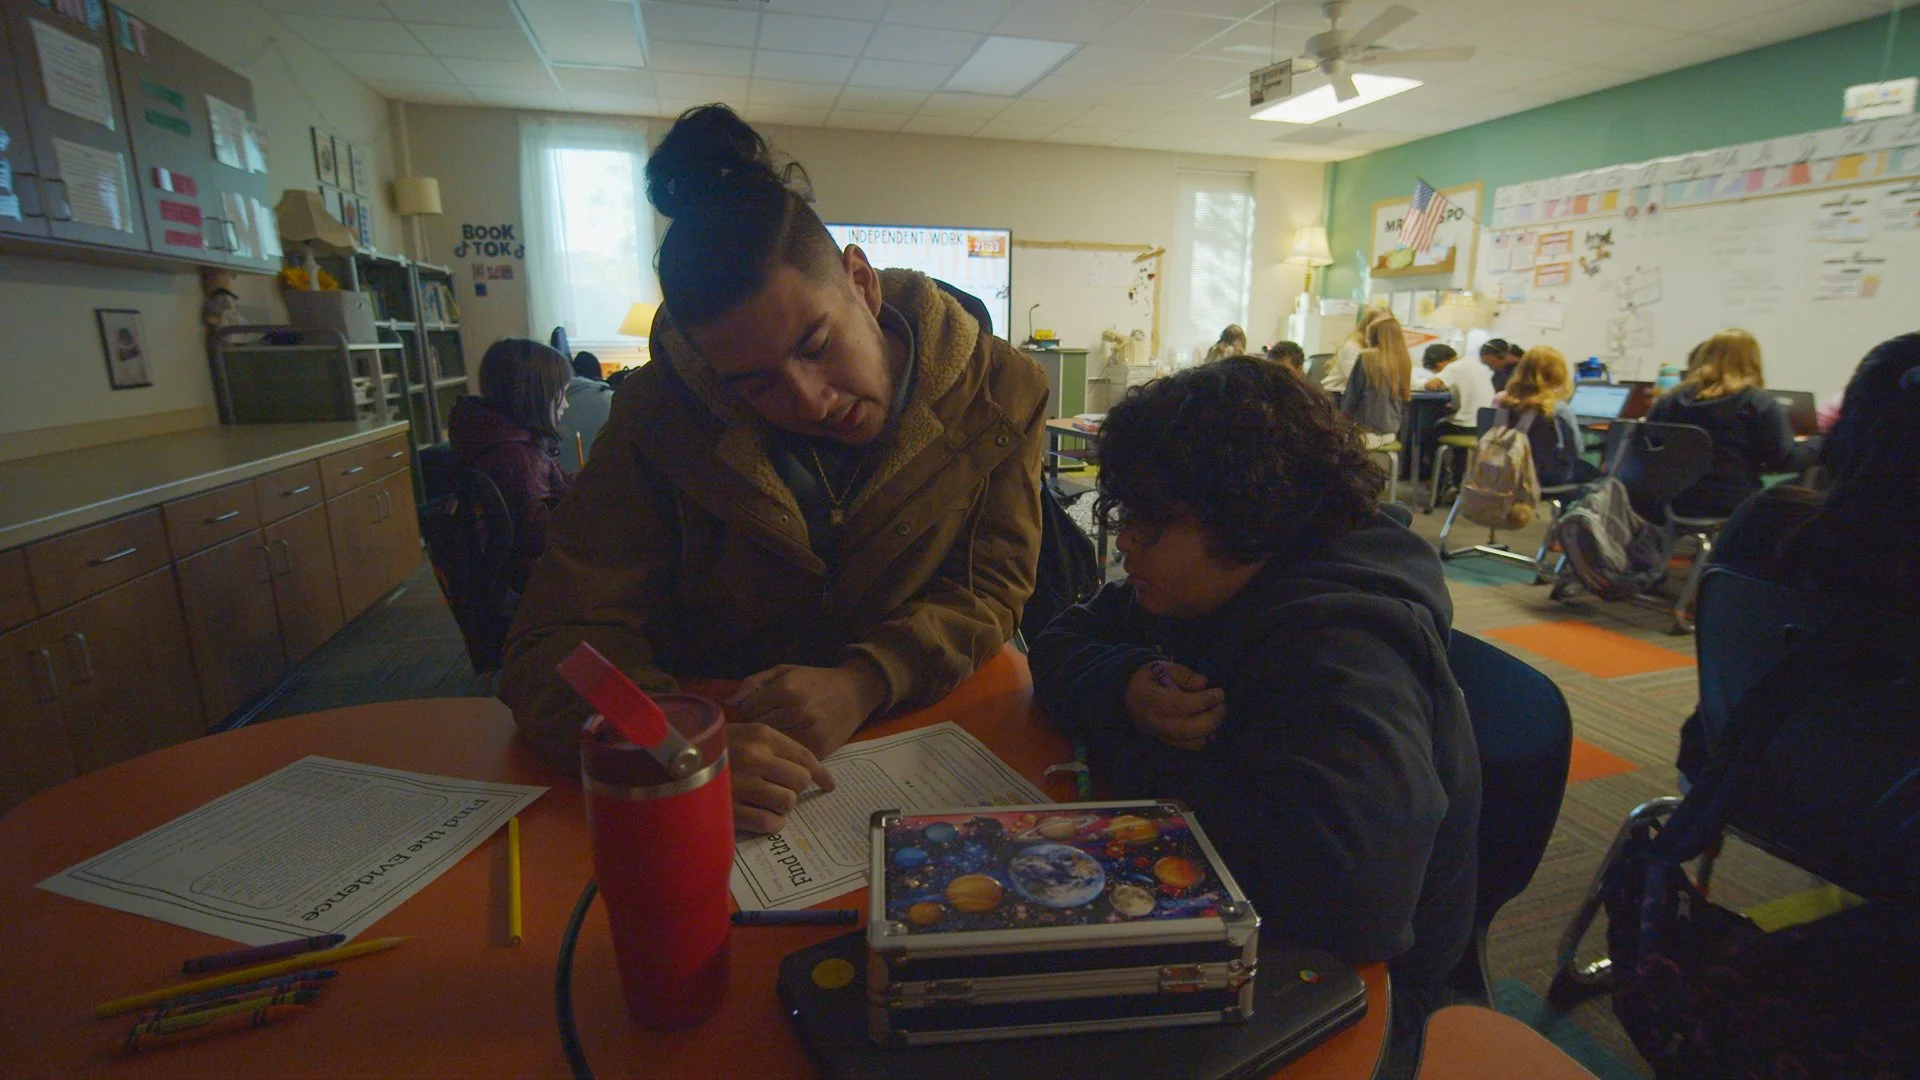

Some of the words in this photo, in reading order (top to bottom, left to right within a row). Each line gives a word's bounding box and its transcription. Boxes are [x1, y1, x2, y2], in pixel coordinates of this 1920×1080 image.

[462, 223, 515, 240] BOOK
[848, 229, 925, 245] INDEPENDENT
[929, 231, 964, 247] WORK
[473, 241, 512, 257] TOK
[443, 799, 489, 828] Find
[408, 829, 447, 852] the
[767, 832, 791, 856] the
[777, 855, 813, 887] Find
[301, 853, 411, 921] Evidence
